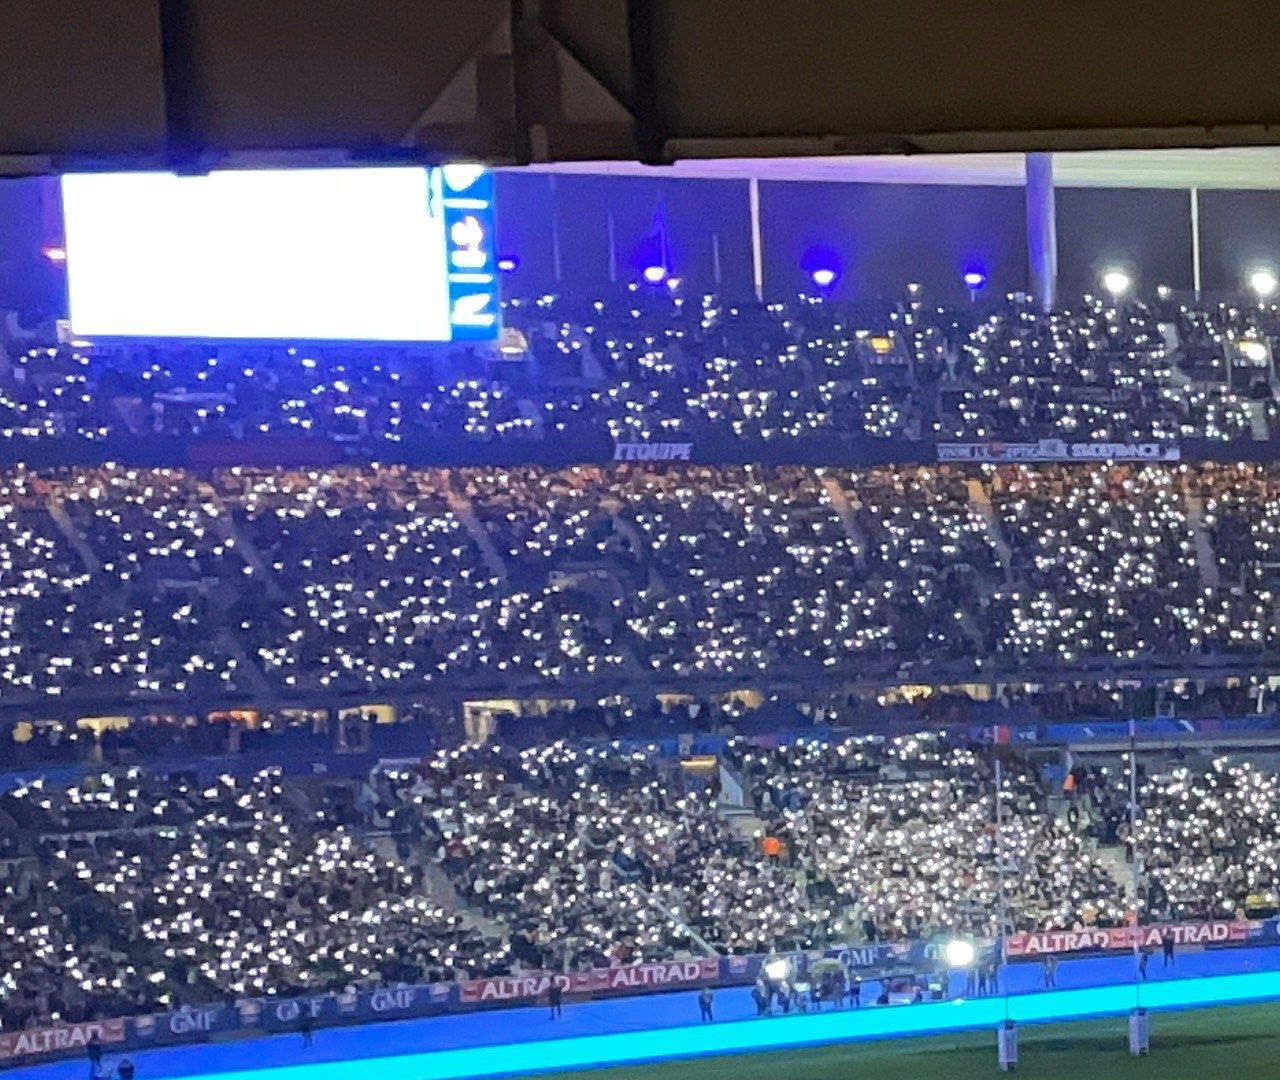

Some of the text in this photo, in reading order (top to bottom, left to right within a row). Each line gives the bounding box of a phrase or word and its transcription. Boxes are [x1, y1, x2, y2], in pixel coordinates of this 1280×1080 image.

[1025, 930, 1111, 955] ALTRAD
[837, 949, 880, 968] GMF
[612, 962, 700, 989] ALTRAD
[170, 1010, 217, 1034] GMF
